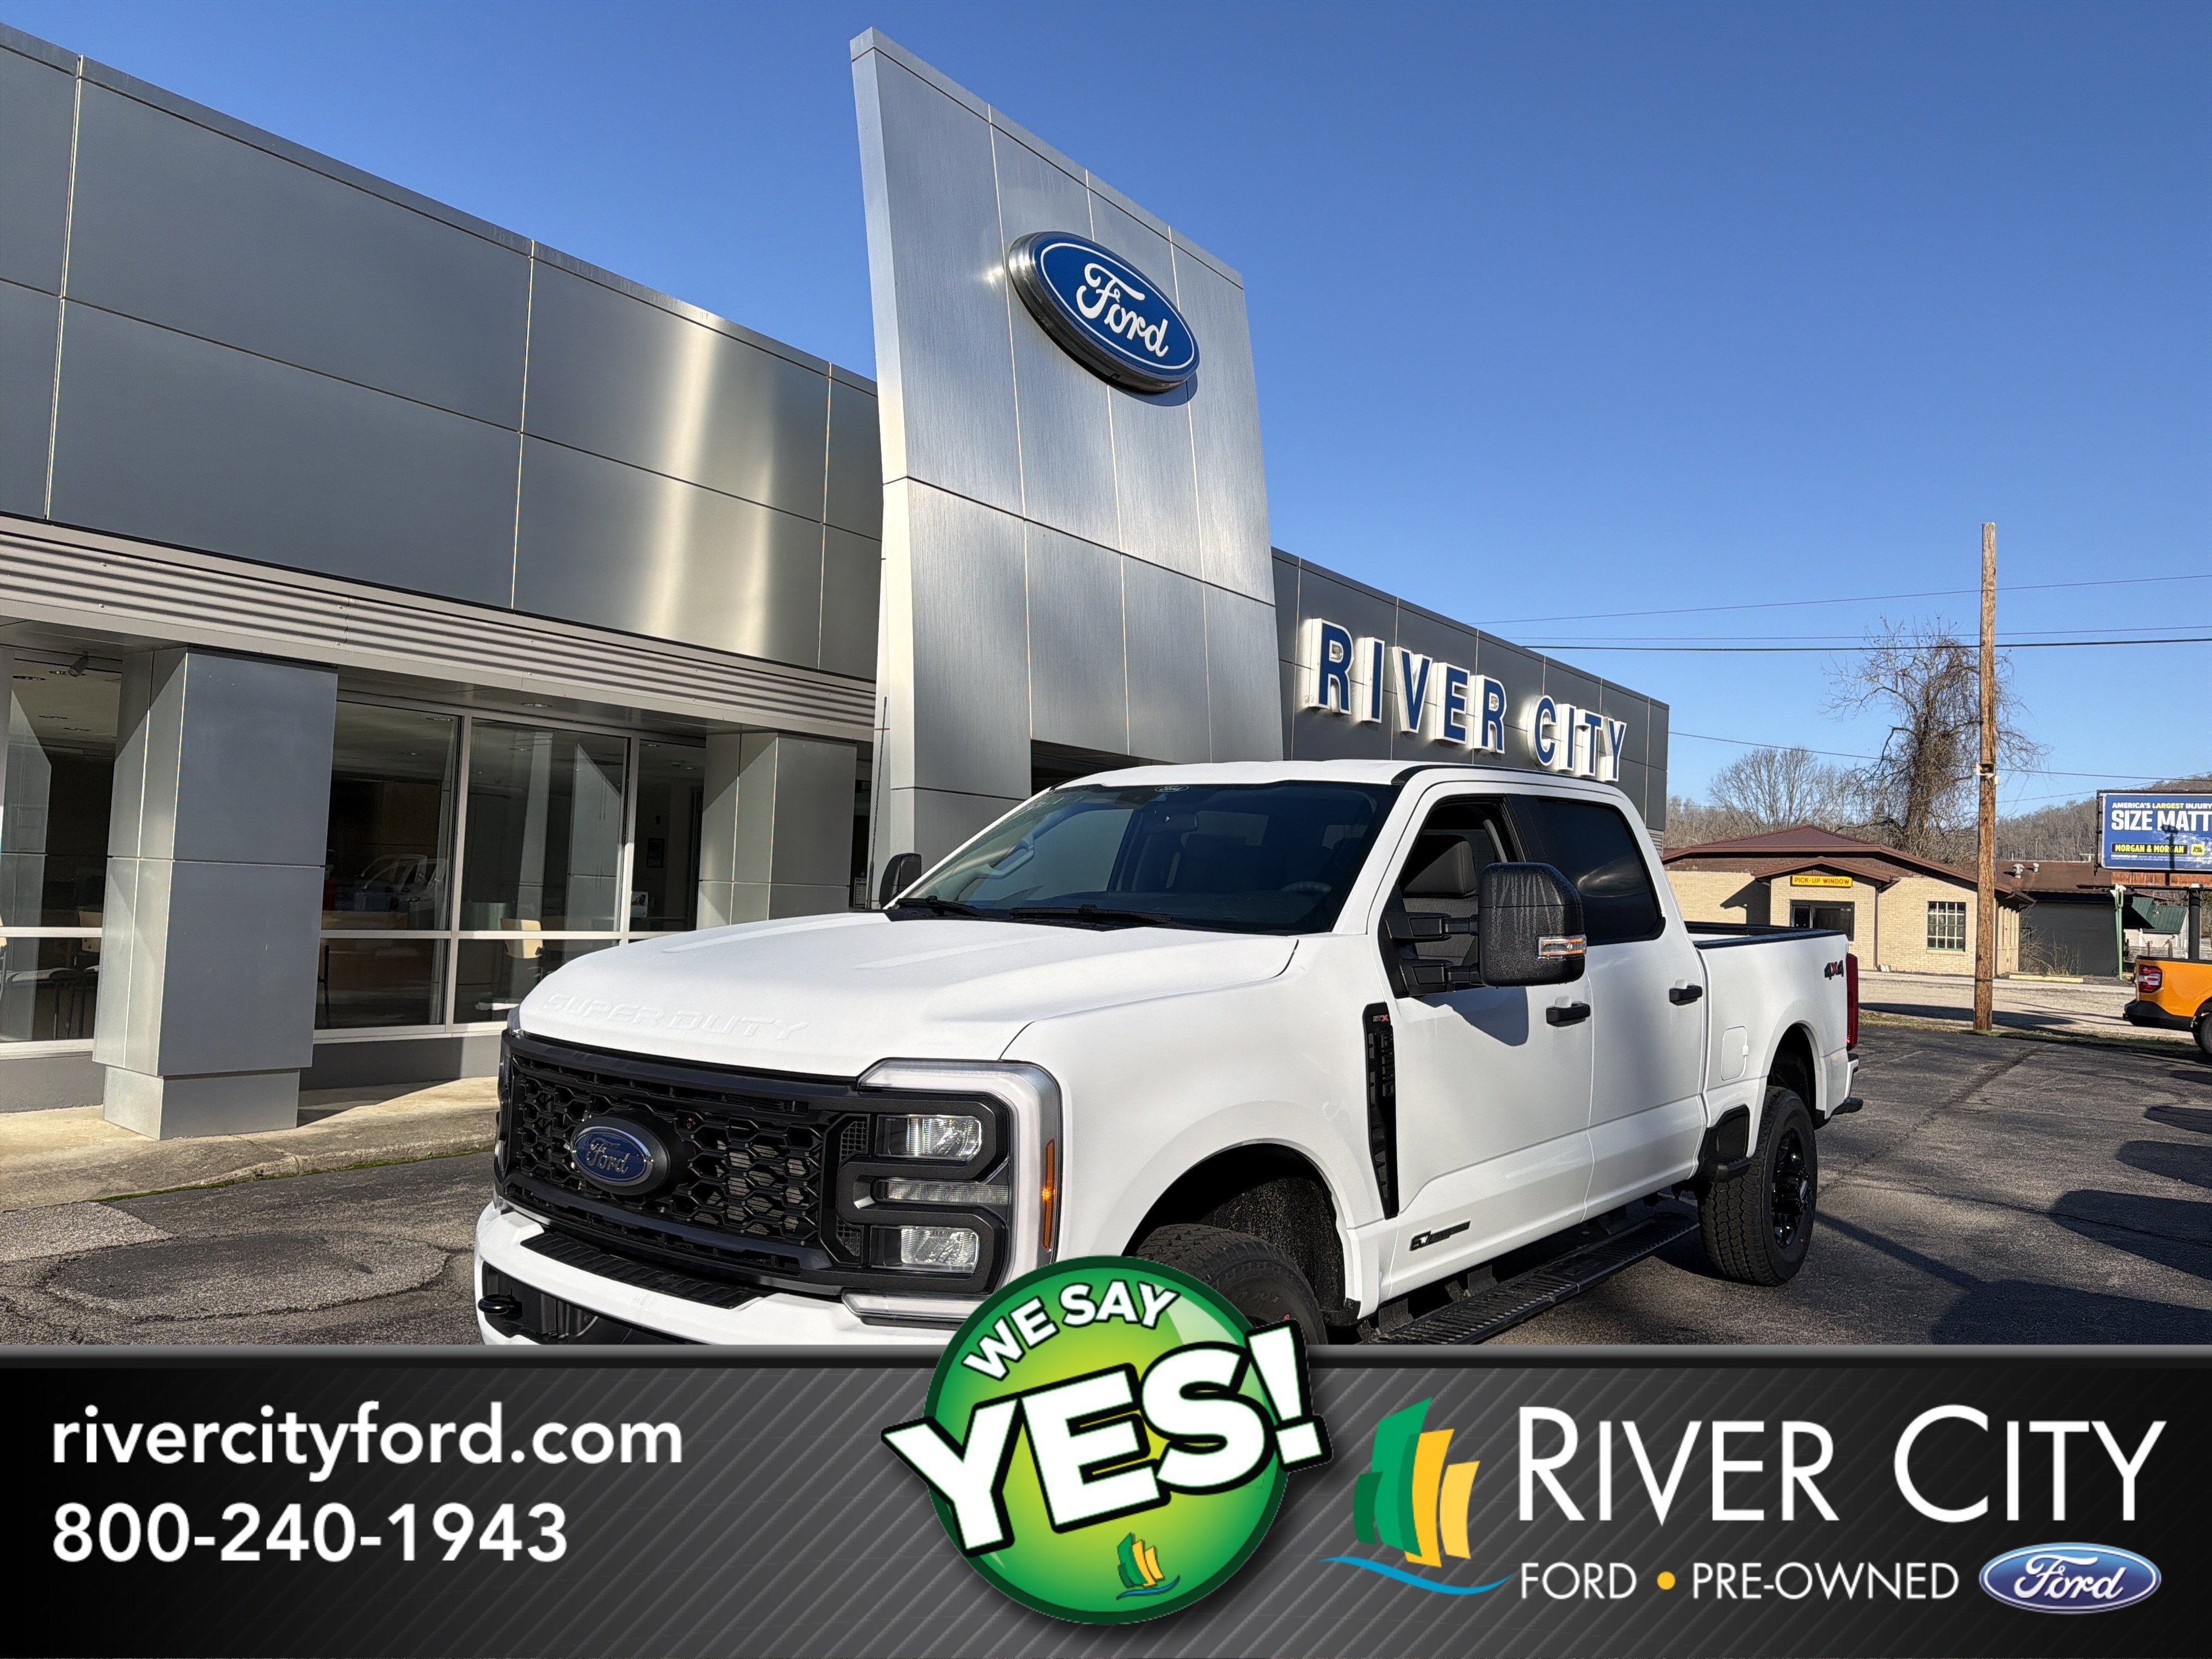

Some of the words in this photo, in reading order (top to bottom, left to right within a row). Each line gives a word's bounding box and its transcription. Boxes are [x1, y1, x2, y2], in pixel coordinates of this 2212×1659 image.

[1076, 262, 1169, 357] Ford
[1309, 618, 1508, 755] RIVER
[1530, 695, 1627, 782] CITY
[2112, 810, 2153, 831] SIZE
[2157, 810, 2212, 832] MATT
[542, 994, 667, 1027] SUPER
[667, 1009, 810, 1041] DUTY
[585, 1137, 631, 1174] Ford
